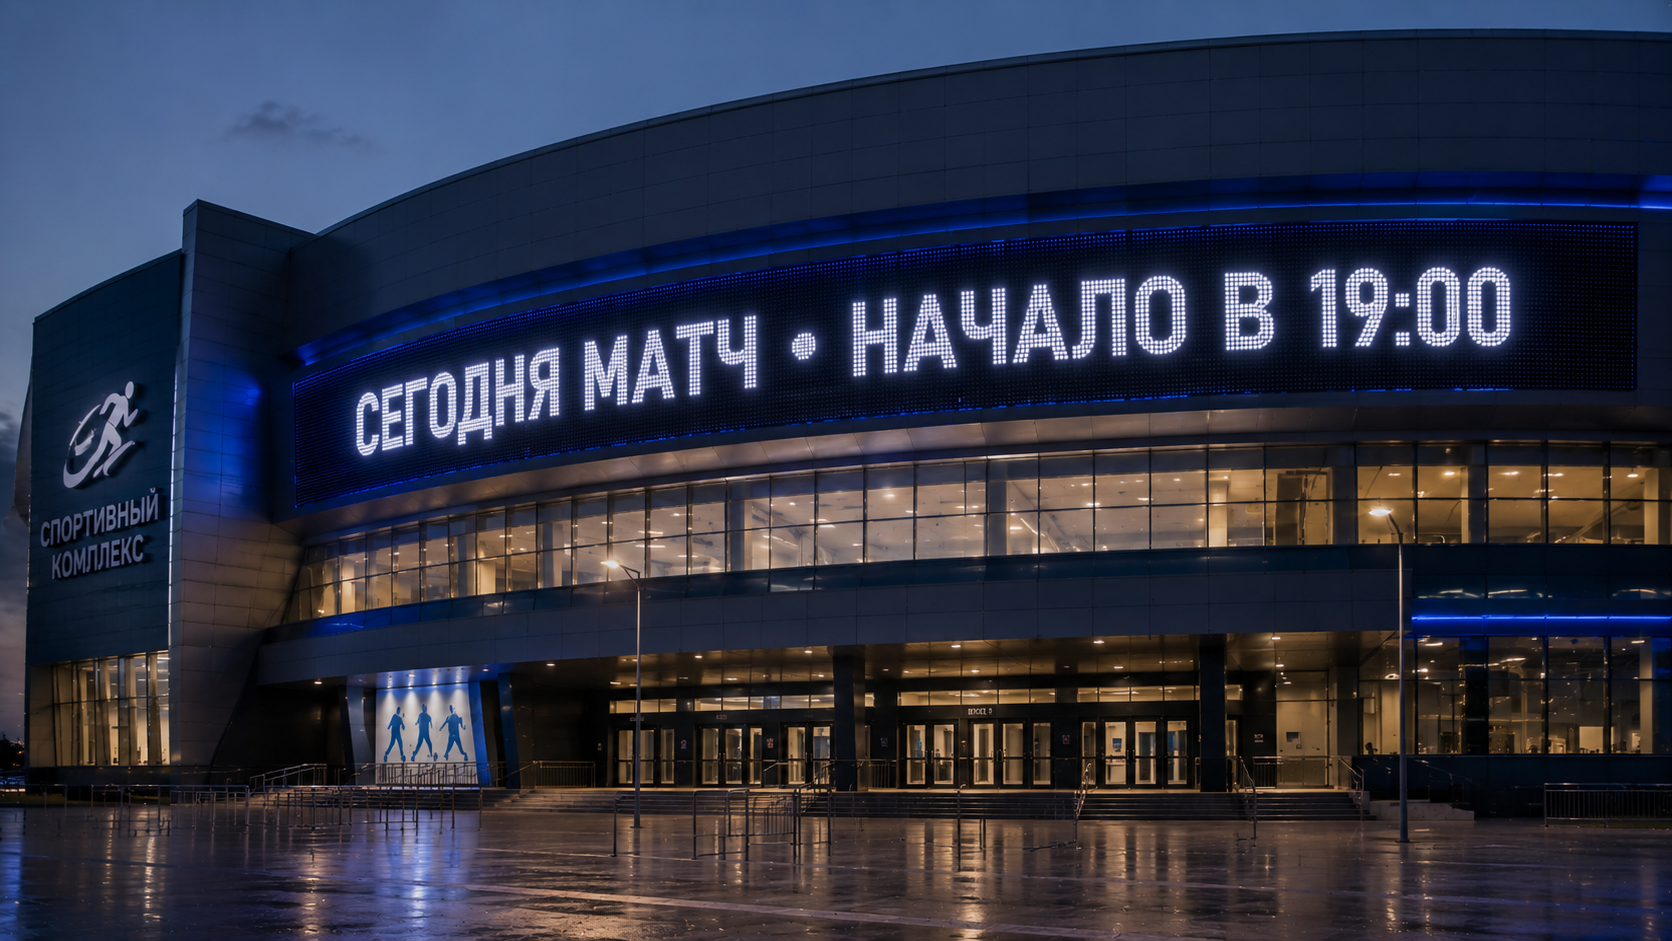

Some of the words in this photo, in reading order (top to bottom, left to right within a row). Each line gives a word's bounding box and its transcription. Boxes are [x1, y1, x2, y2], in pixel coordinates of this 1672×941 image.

[355, 348, 560, 457] СЕГОДНЯ
[584, 315, 757, 412] МАТЧ
[852, 275, 1187, 377] НАЧАЛО
[1224, 271, 1275, 351] В
[1310, 267, 1511, 347] 19:00
[40, 487, 159, 548] СПОРТИВНЫЙ
